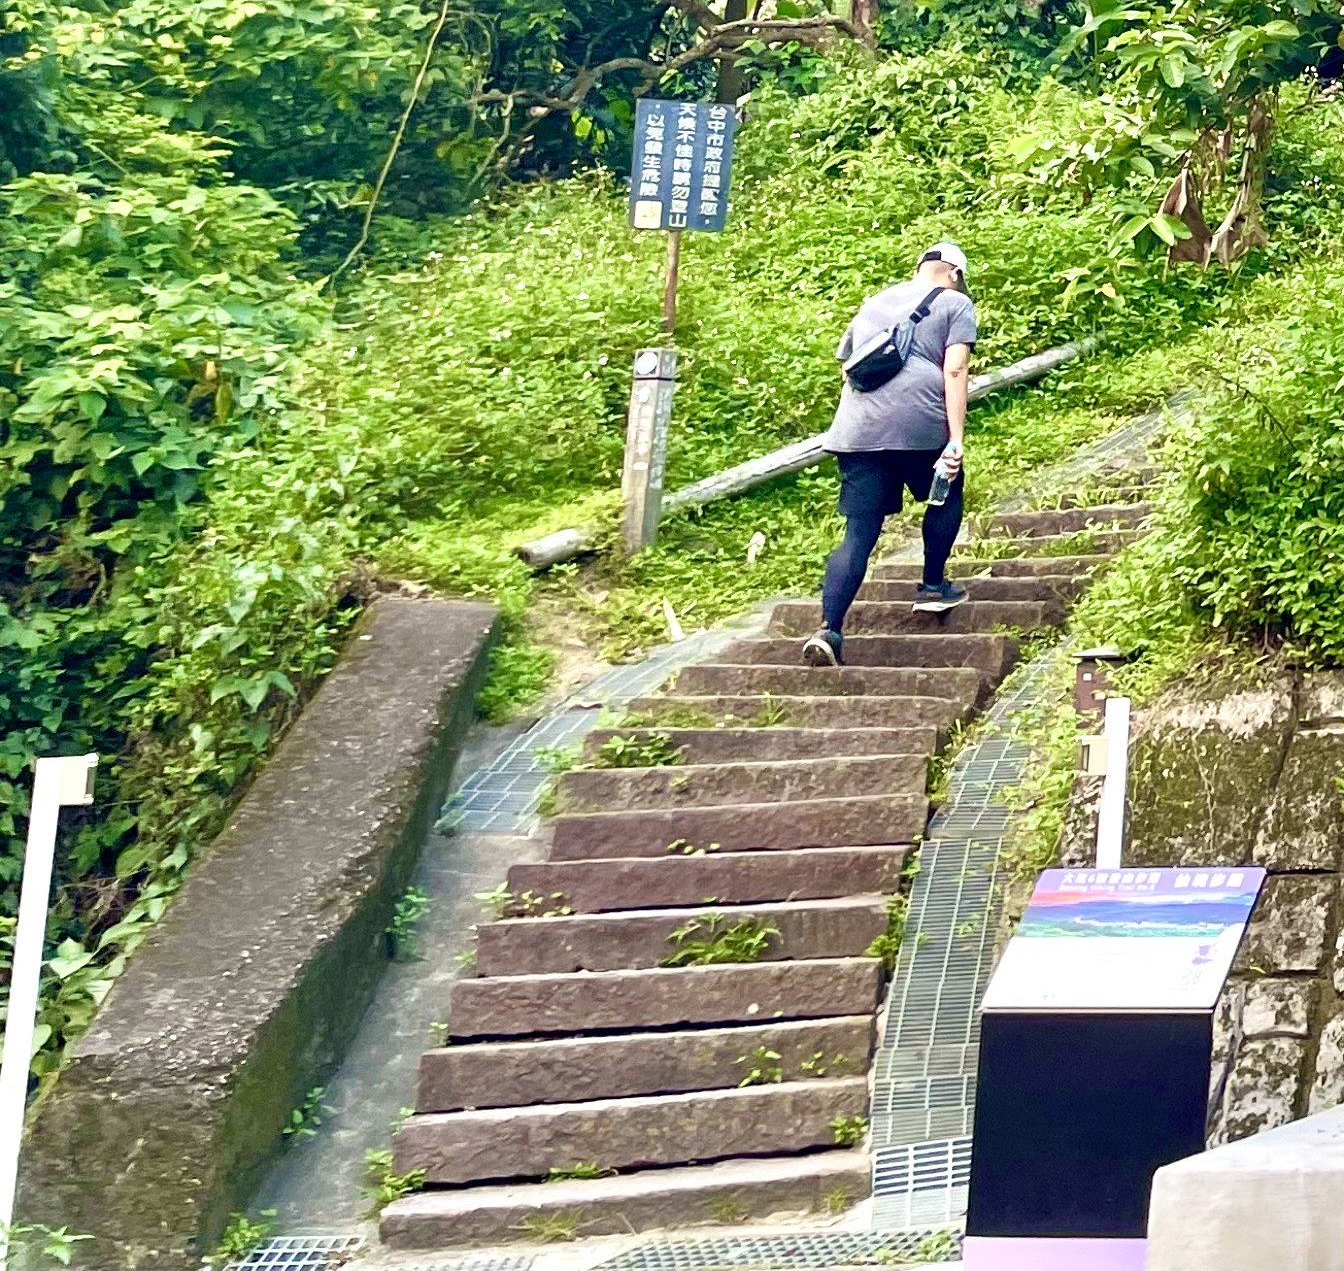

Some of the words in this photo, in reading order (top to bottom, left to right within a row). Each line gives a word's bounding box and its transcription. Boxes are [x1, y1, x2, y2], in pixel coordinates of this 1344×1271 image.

[668, 102, 698, 228] 天候不佳時請勿登山
